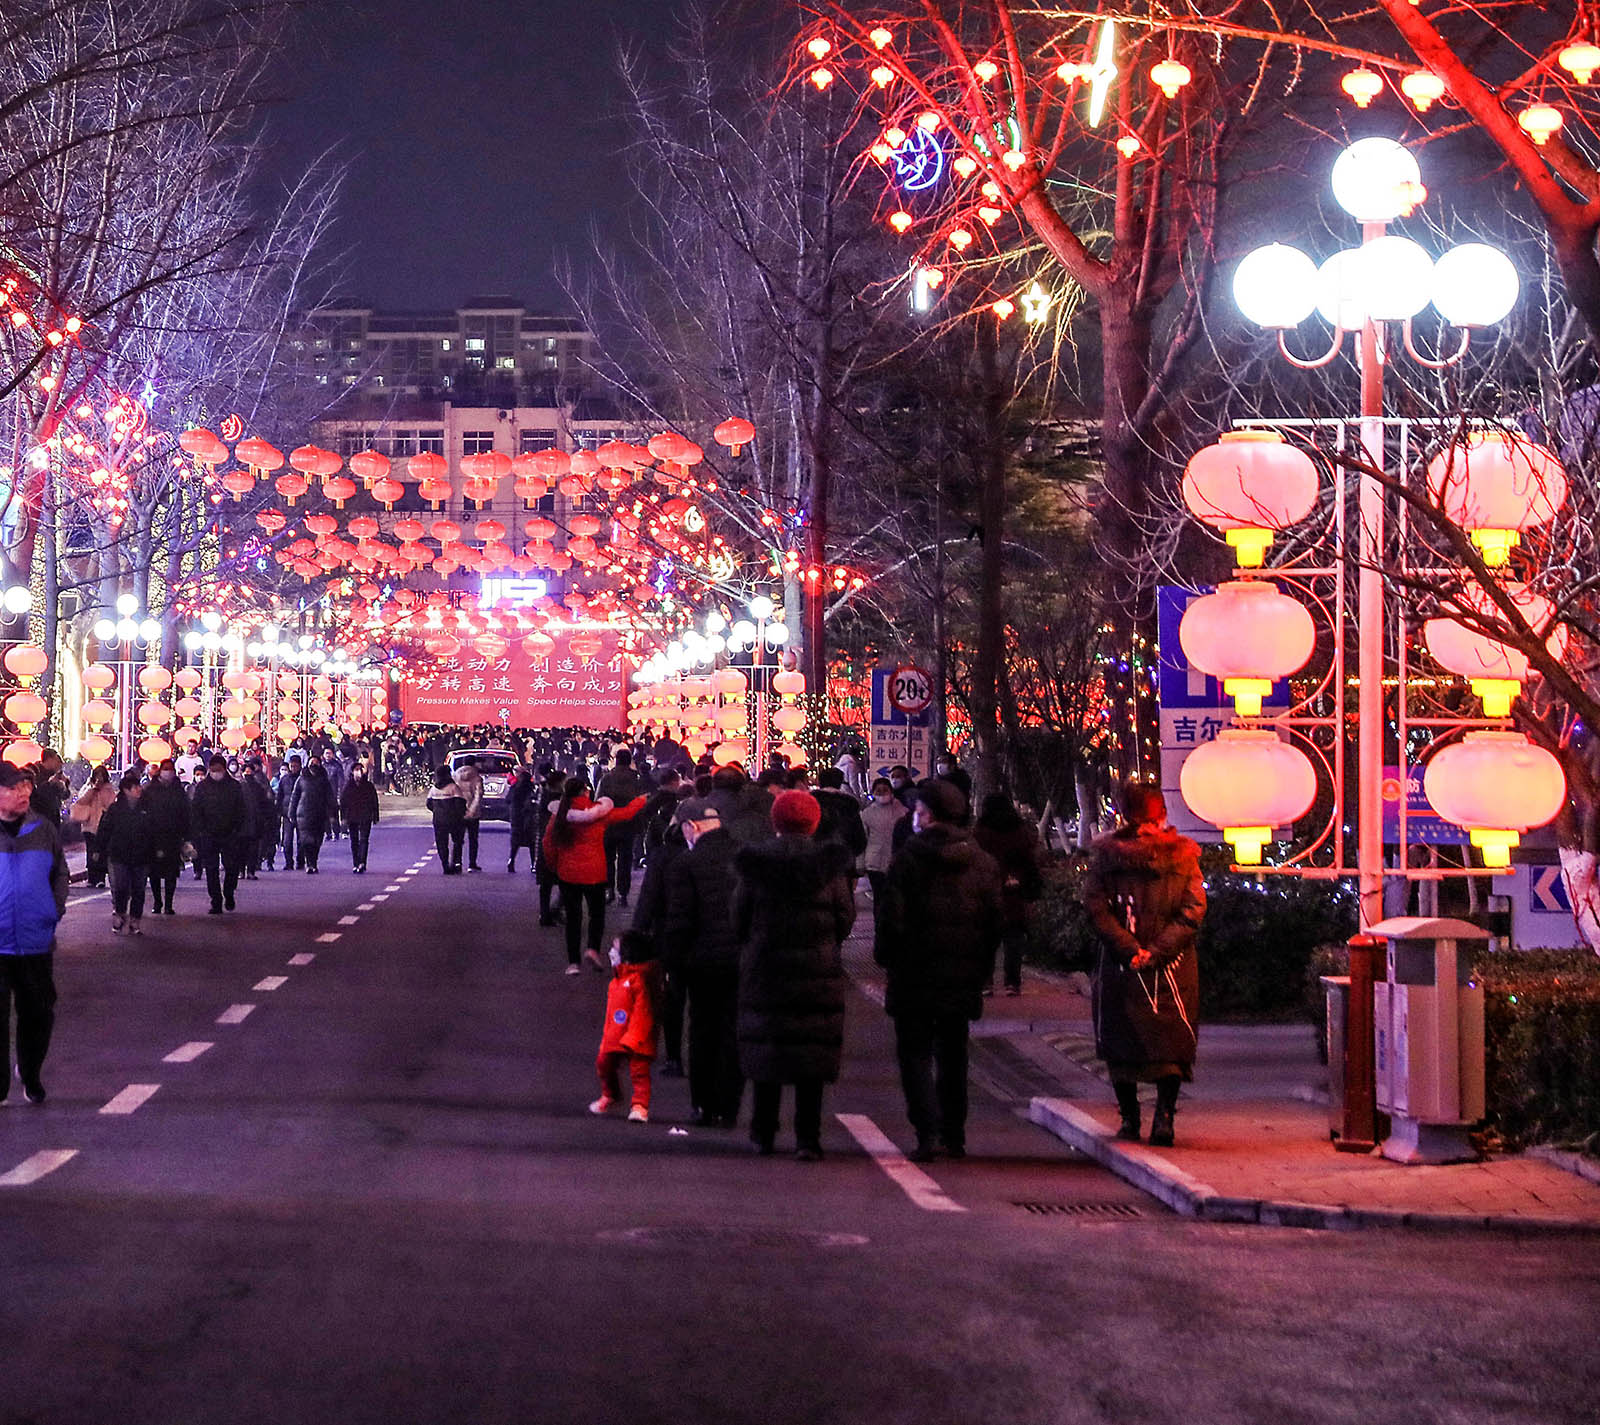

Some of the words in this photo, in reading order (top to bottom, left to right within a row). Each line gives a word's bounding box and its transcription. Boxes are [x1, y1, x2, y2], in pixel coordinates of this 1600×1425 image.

[416, 696, 458, 705] Pressure
[460, 696, 491, 705] Makes
[493, 696, 520, 705] Value
[527, 697, 558, 706] Speed
[560, 697, 587, 706] Helps
